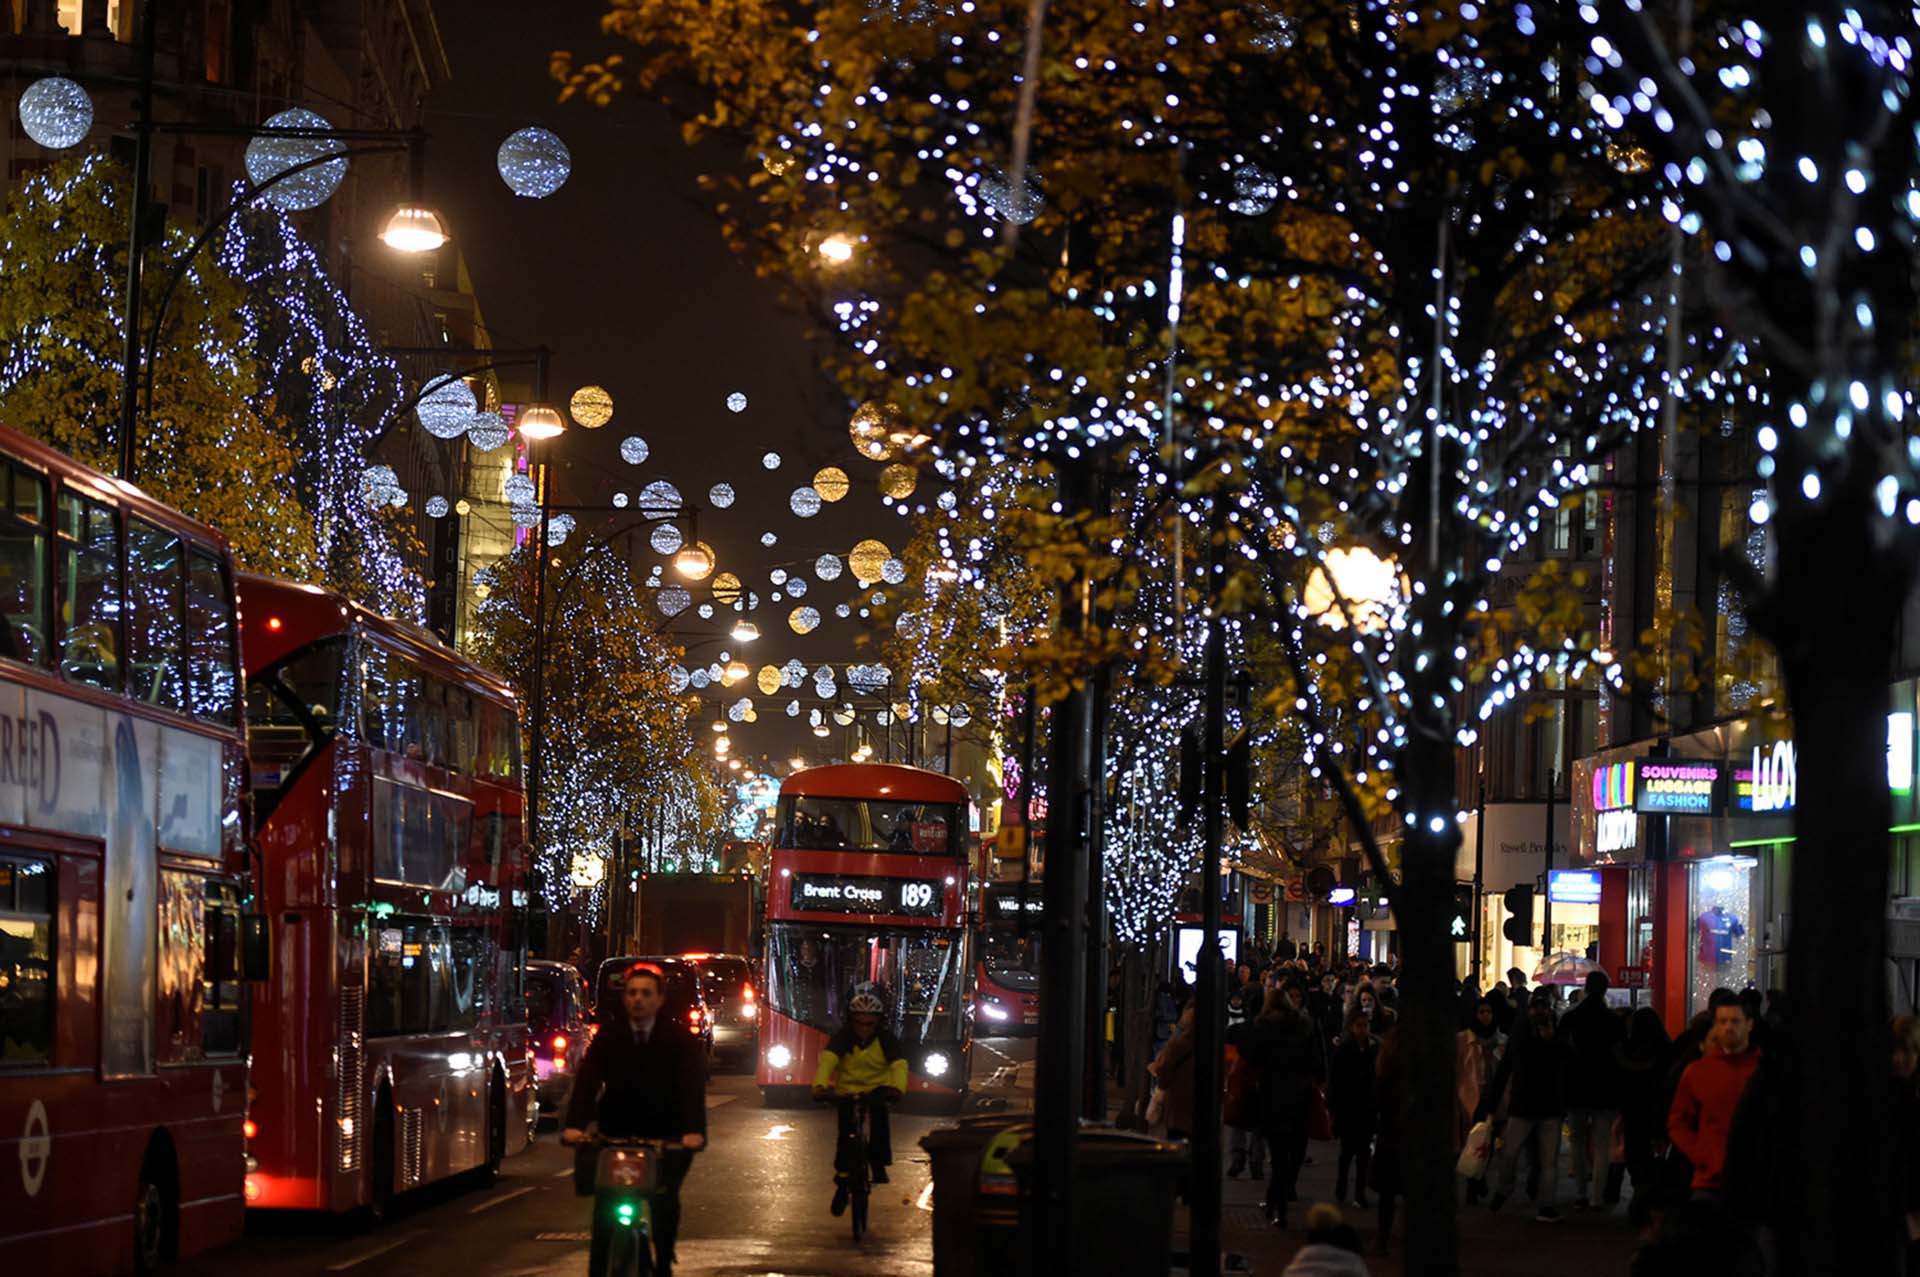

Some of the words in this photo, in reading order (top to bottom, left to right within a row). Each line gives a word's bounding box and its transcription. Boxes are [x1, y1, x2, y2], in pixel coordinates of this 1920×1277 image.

[1641, 765, 1718, 781] SOUVENIRS
[1646, 779, 1712, 794] LUGGAGE
[1648, 794, 1709, 808] FASHION
[804, 883, 840, 898] Brent
[844, 885, 882, 900] Cross
[901, 883, 932, 907] 189
